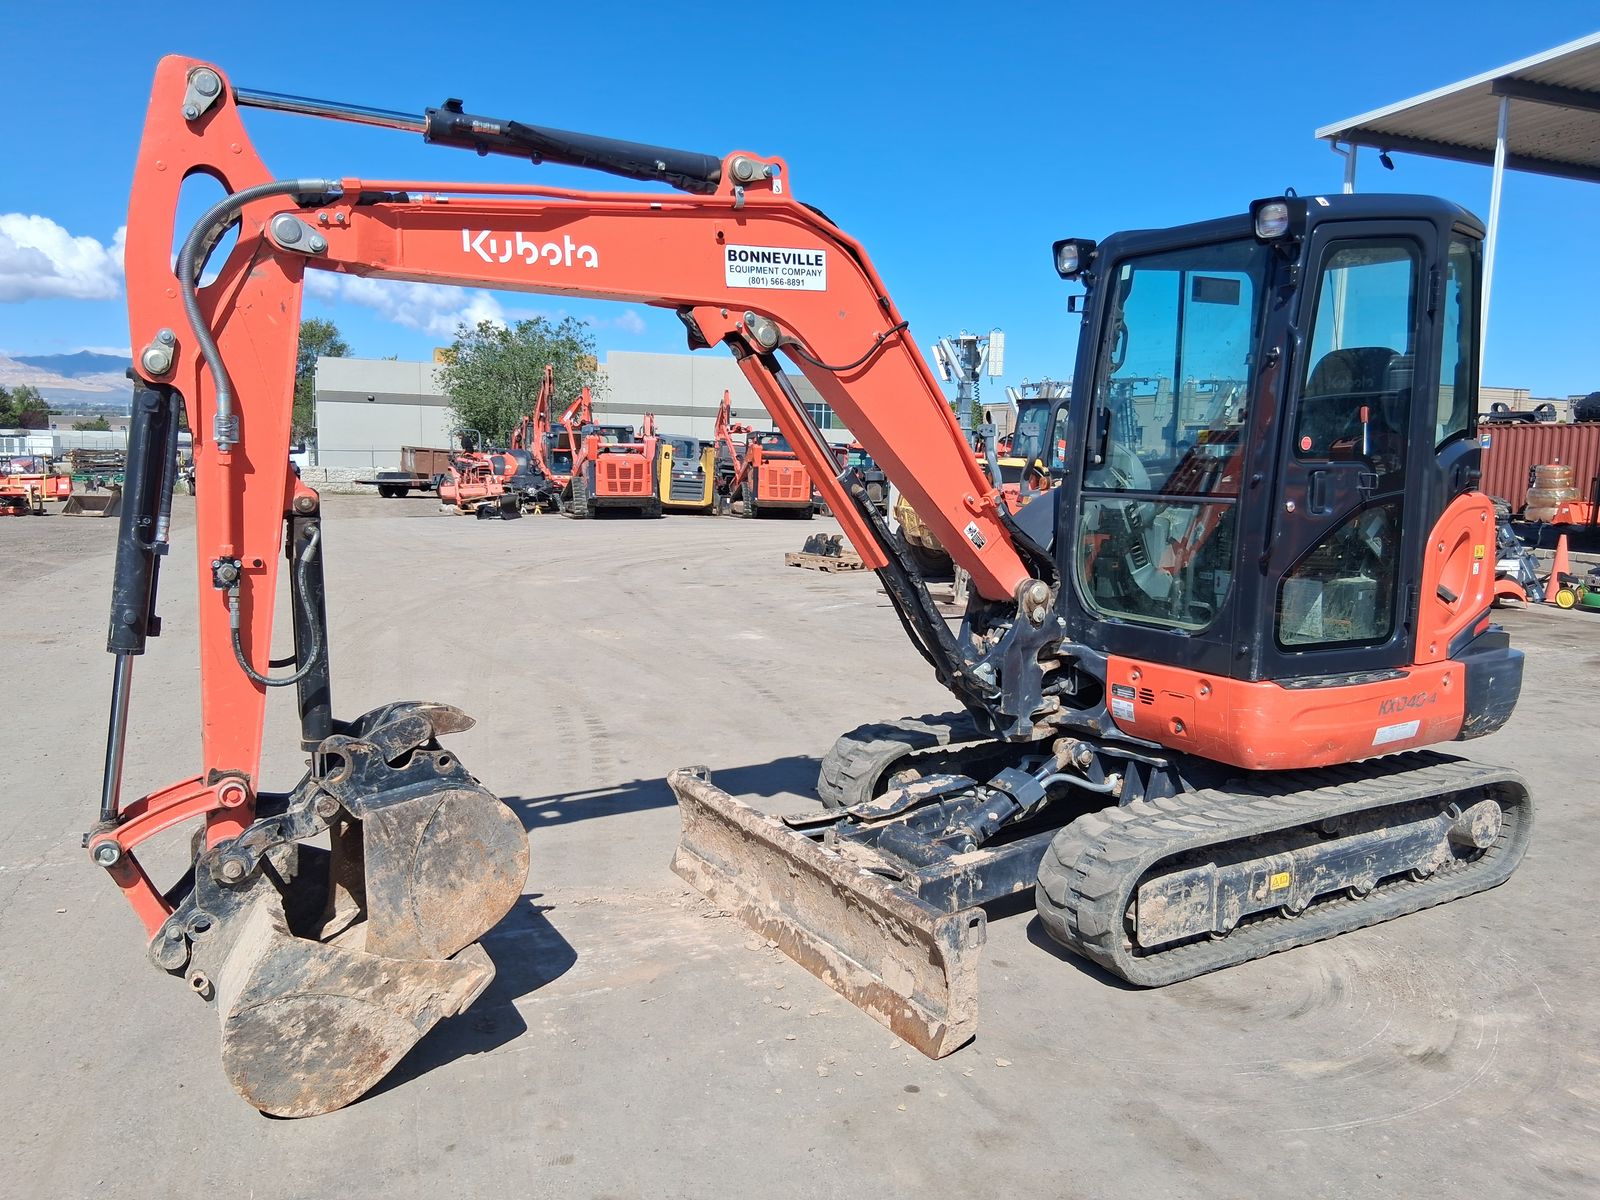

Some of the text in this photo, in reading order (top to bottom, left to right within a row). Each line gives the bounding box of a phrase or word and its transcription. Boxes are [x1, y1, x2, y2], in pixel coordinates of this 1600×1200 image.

[462, 229, 599, 268] Kubota
[727, 249, 823, 266] BONNEVILLE
[729, 265, 822, 277] EQUIPMENT COMPANY
[748, 277, 805, 287] (801) 566-8891
